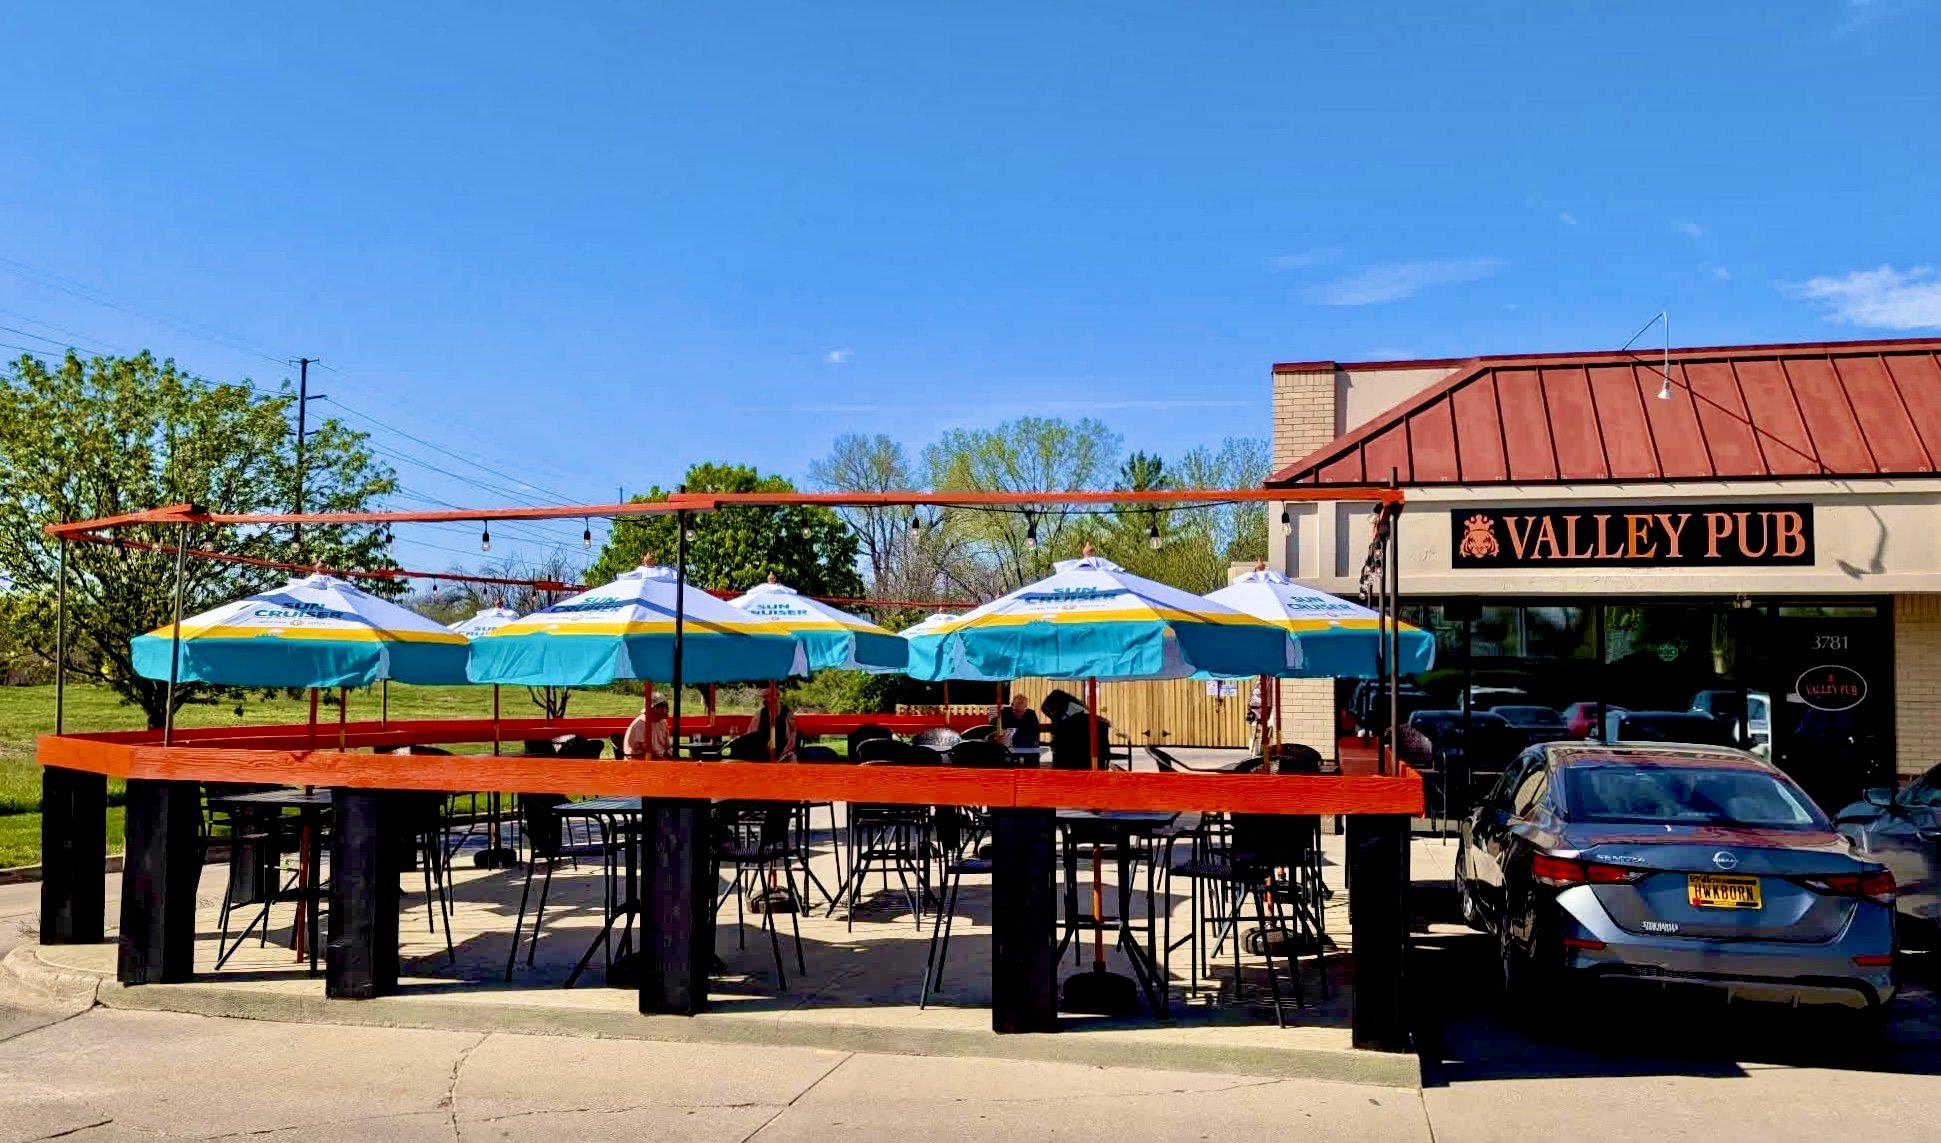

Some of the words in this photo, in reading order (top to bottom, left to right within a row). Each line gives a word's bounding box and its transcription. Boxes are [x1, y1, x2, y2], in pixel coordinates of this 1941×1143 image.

[1502, 513, 1693, 560] VALLEY
[1702, 511, 1807, 558] PUB
[1053, 586, 1097, 595] SUN
[580, 596, 620, 605] SUN
[282, 602, 326, 611] SUN
[254, 609, 344, 619] CRUISER
[1811, 635, 1848, 650] 3781
[1806, 684, 1838, 695] VALLEY
[1840, 685, 1858, 696] PUB
